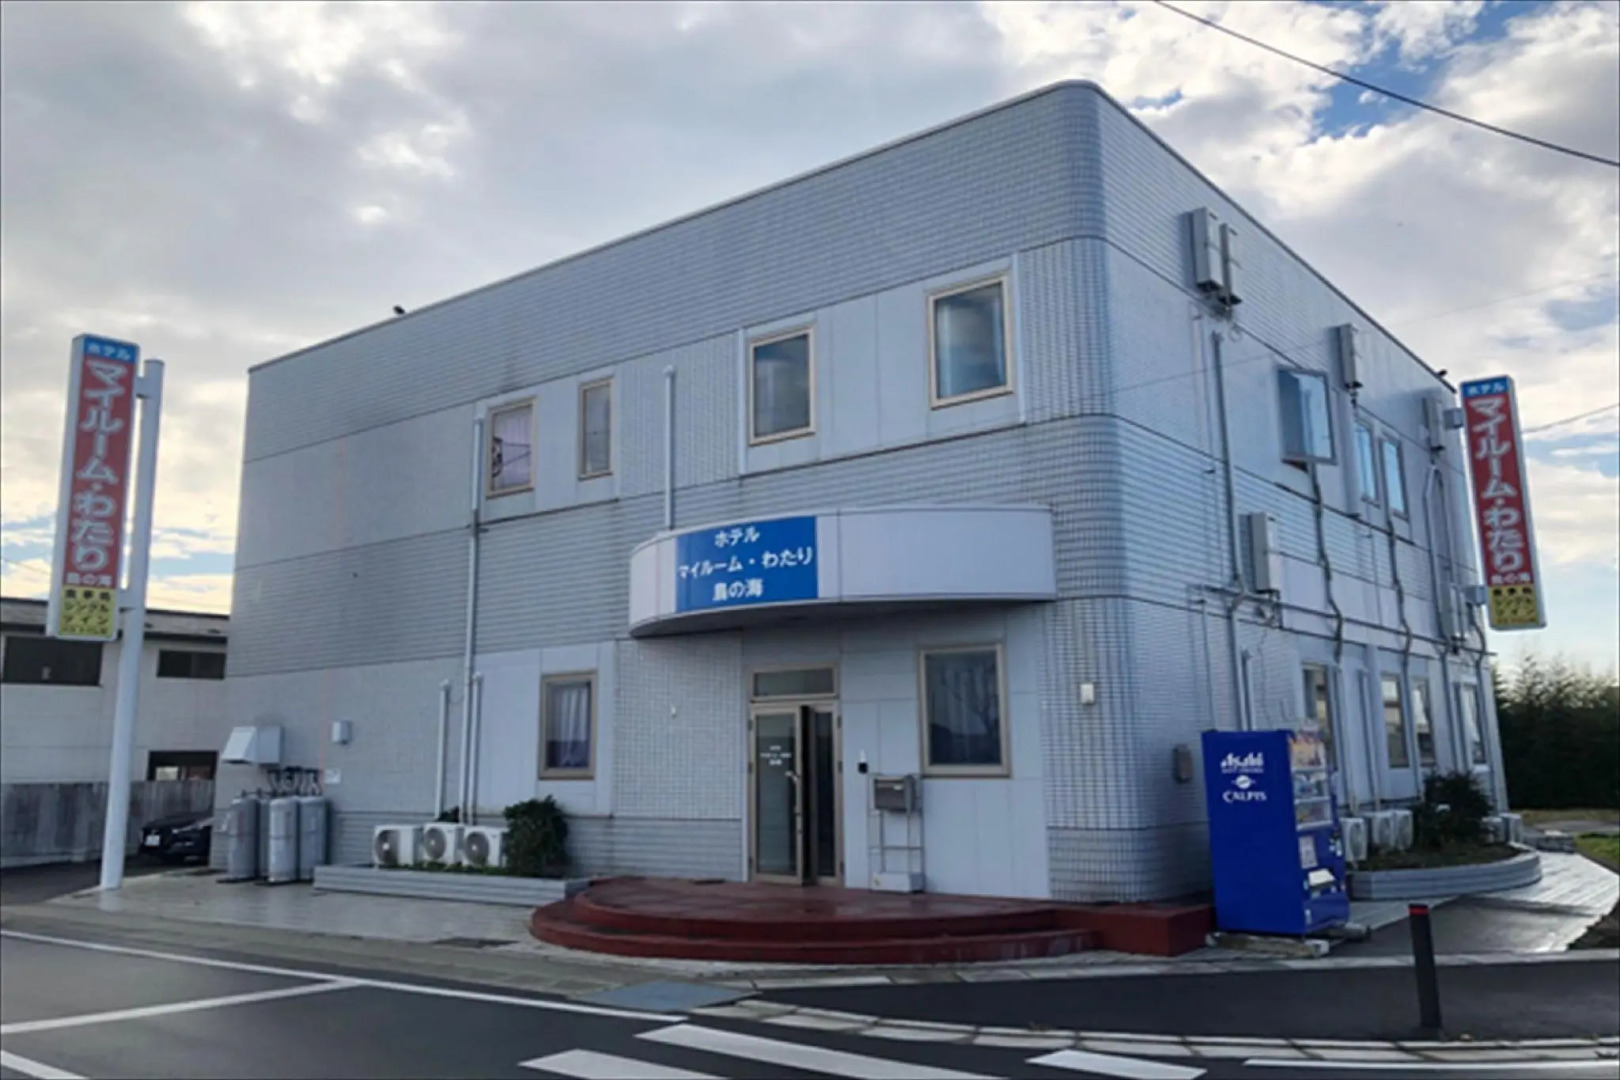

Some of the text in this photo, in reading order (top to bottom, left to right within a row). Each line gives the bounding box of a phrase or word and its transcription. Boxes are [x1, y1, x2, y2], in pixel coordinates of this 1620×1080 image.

[87, 343, 131, 361] ホテル
[1467, 382, 1505, 396] ホテル
[71, 360, 127, 571] マイルーム・わたり
[1468, 397, 1525, 572] マイルーム・わたり
[714, 525, 761, 548] ホテル
[678, 546, 813, 579] マイルーム・わたり
[1220, 752, 1264, 769] Asahi
